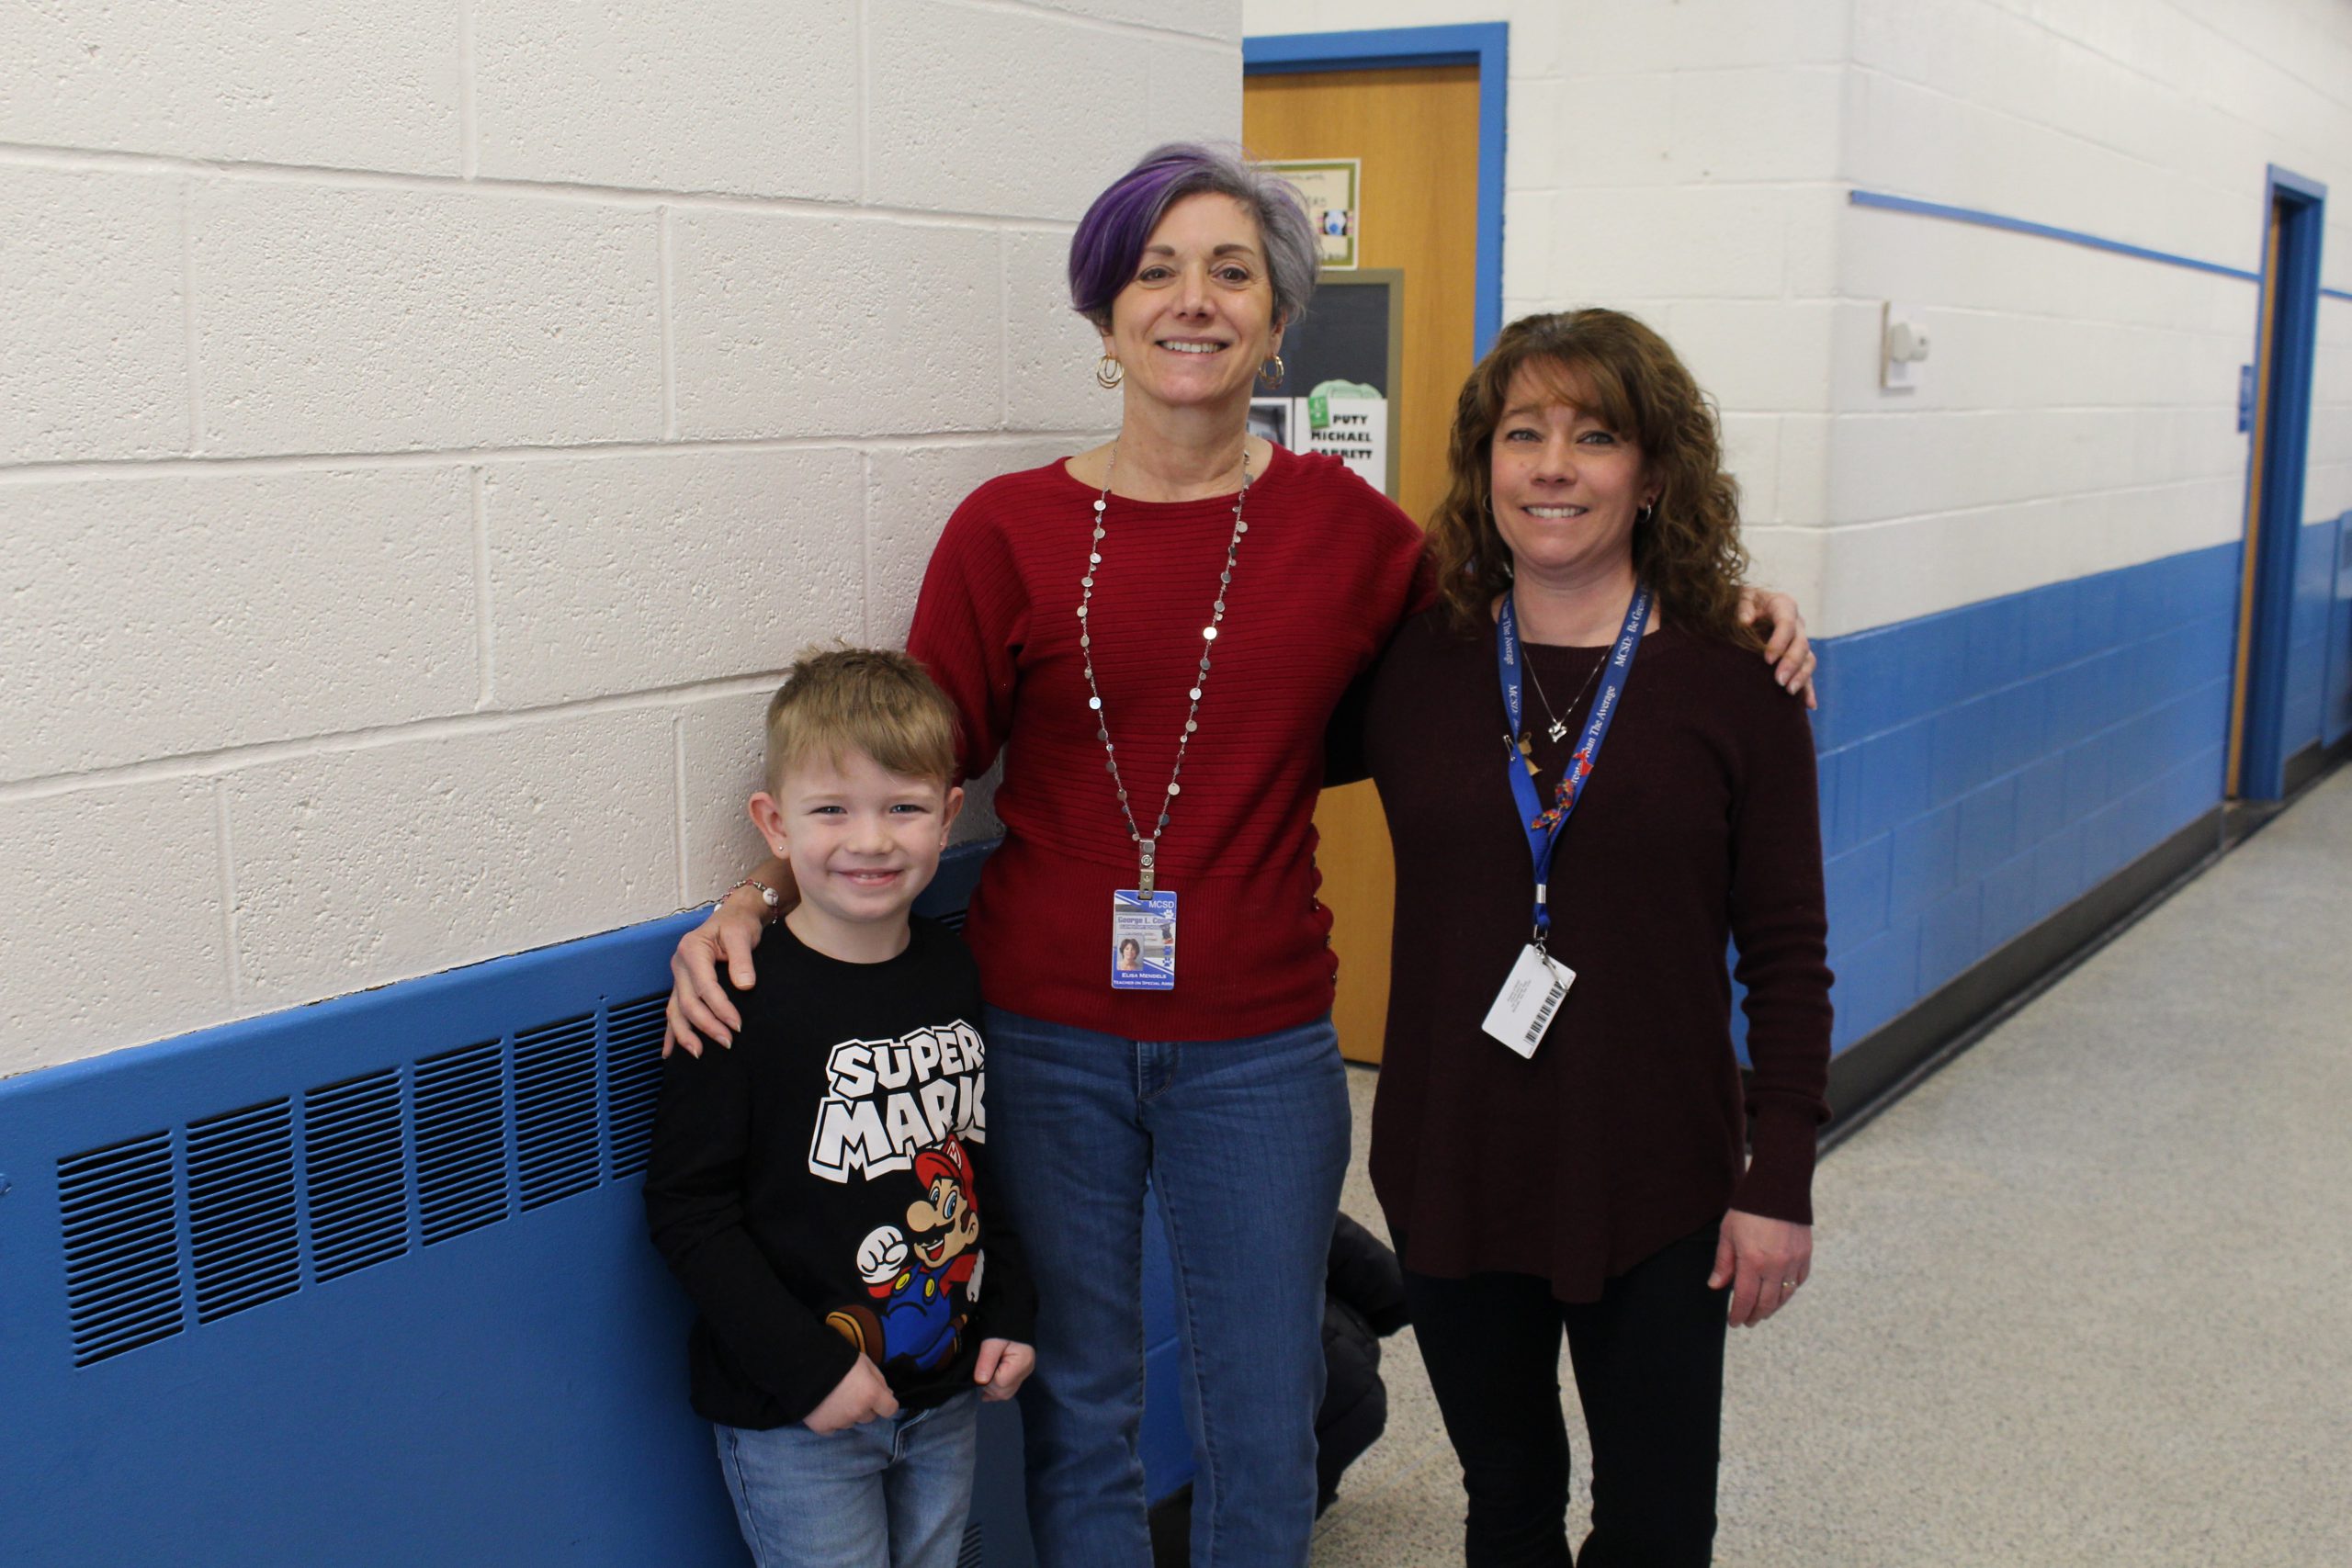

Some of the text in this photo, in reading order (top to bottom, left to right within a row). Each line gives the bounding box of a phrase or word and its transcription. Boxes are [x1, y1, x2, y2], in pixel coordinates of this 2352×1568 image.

[1332, 414, 1368, 424] PUTY
[1311, 432, 1372, 442] MICHAEL
[1502, 618, 1512, 637] The
[1504, 637, 1514, 665] Average
[1614, 636, 1634, 667] MCSD:
[1626, 621, 1639, 633] Be
[1589, 719, 1603, 737] The
[1597, 685, 1616, 720] Average
[1148, 900, 1175, 908] MCSD
[1118, 917, 1143, 925] George
[829, 1021, 985, 1100] SUPER
